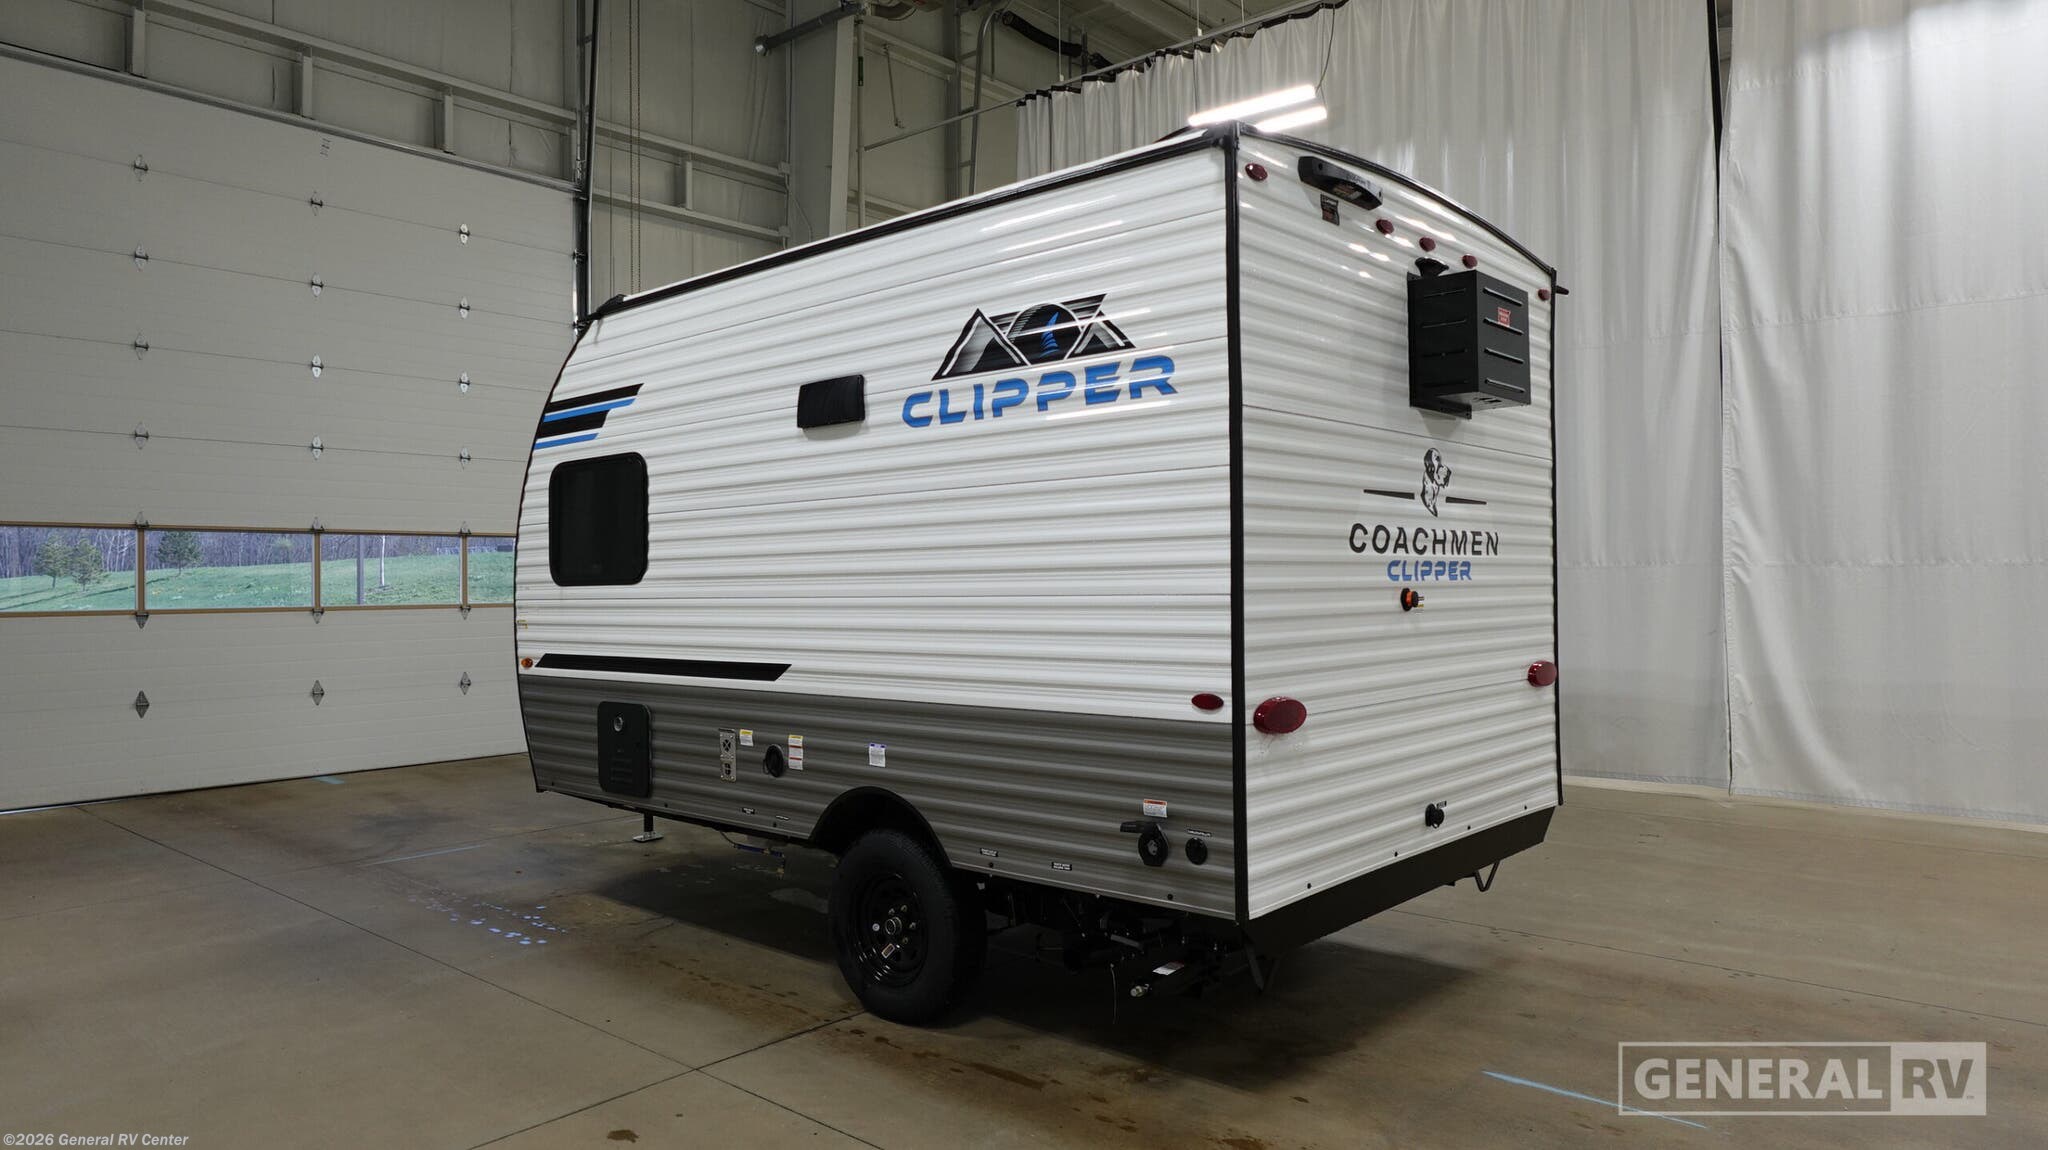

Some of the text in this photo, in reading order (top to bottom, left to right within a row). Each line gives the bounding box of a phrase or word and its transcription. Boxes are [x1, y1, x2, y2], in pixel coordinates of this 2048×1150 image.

[902, 355, 1178, 428] CLIPPER
[1348, 522, 1499, 556] COACHMEN
[1387, 560, 1472, 581] CLIPPER
